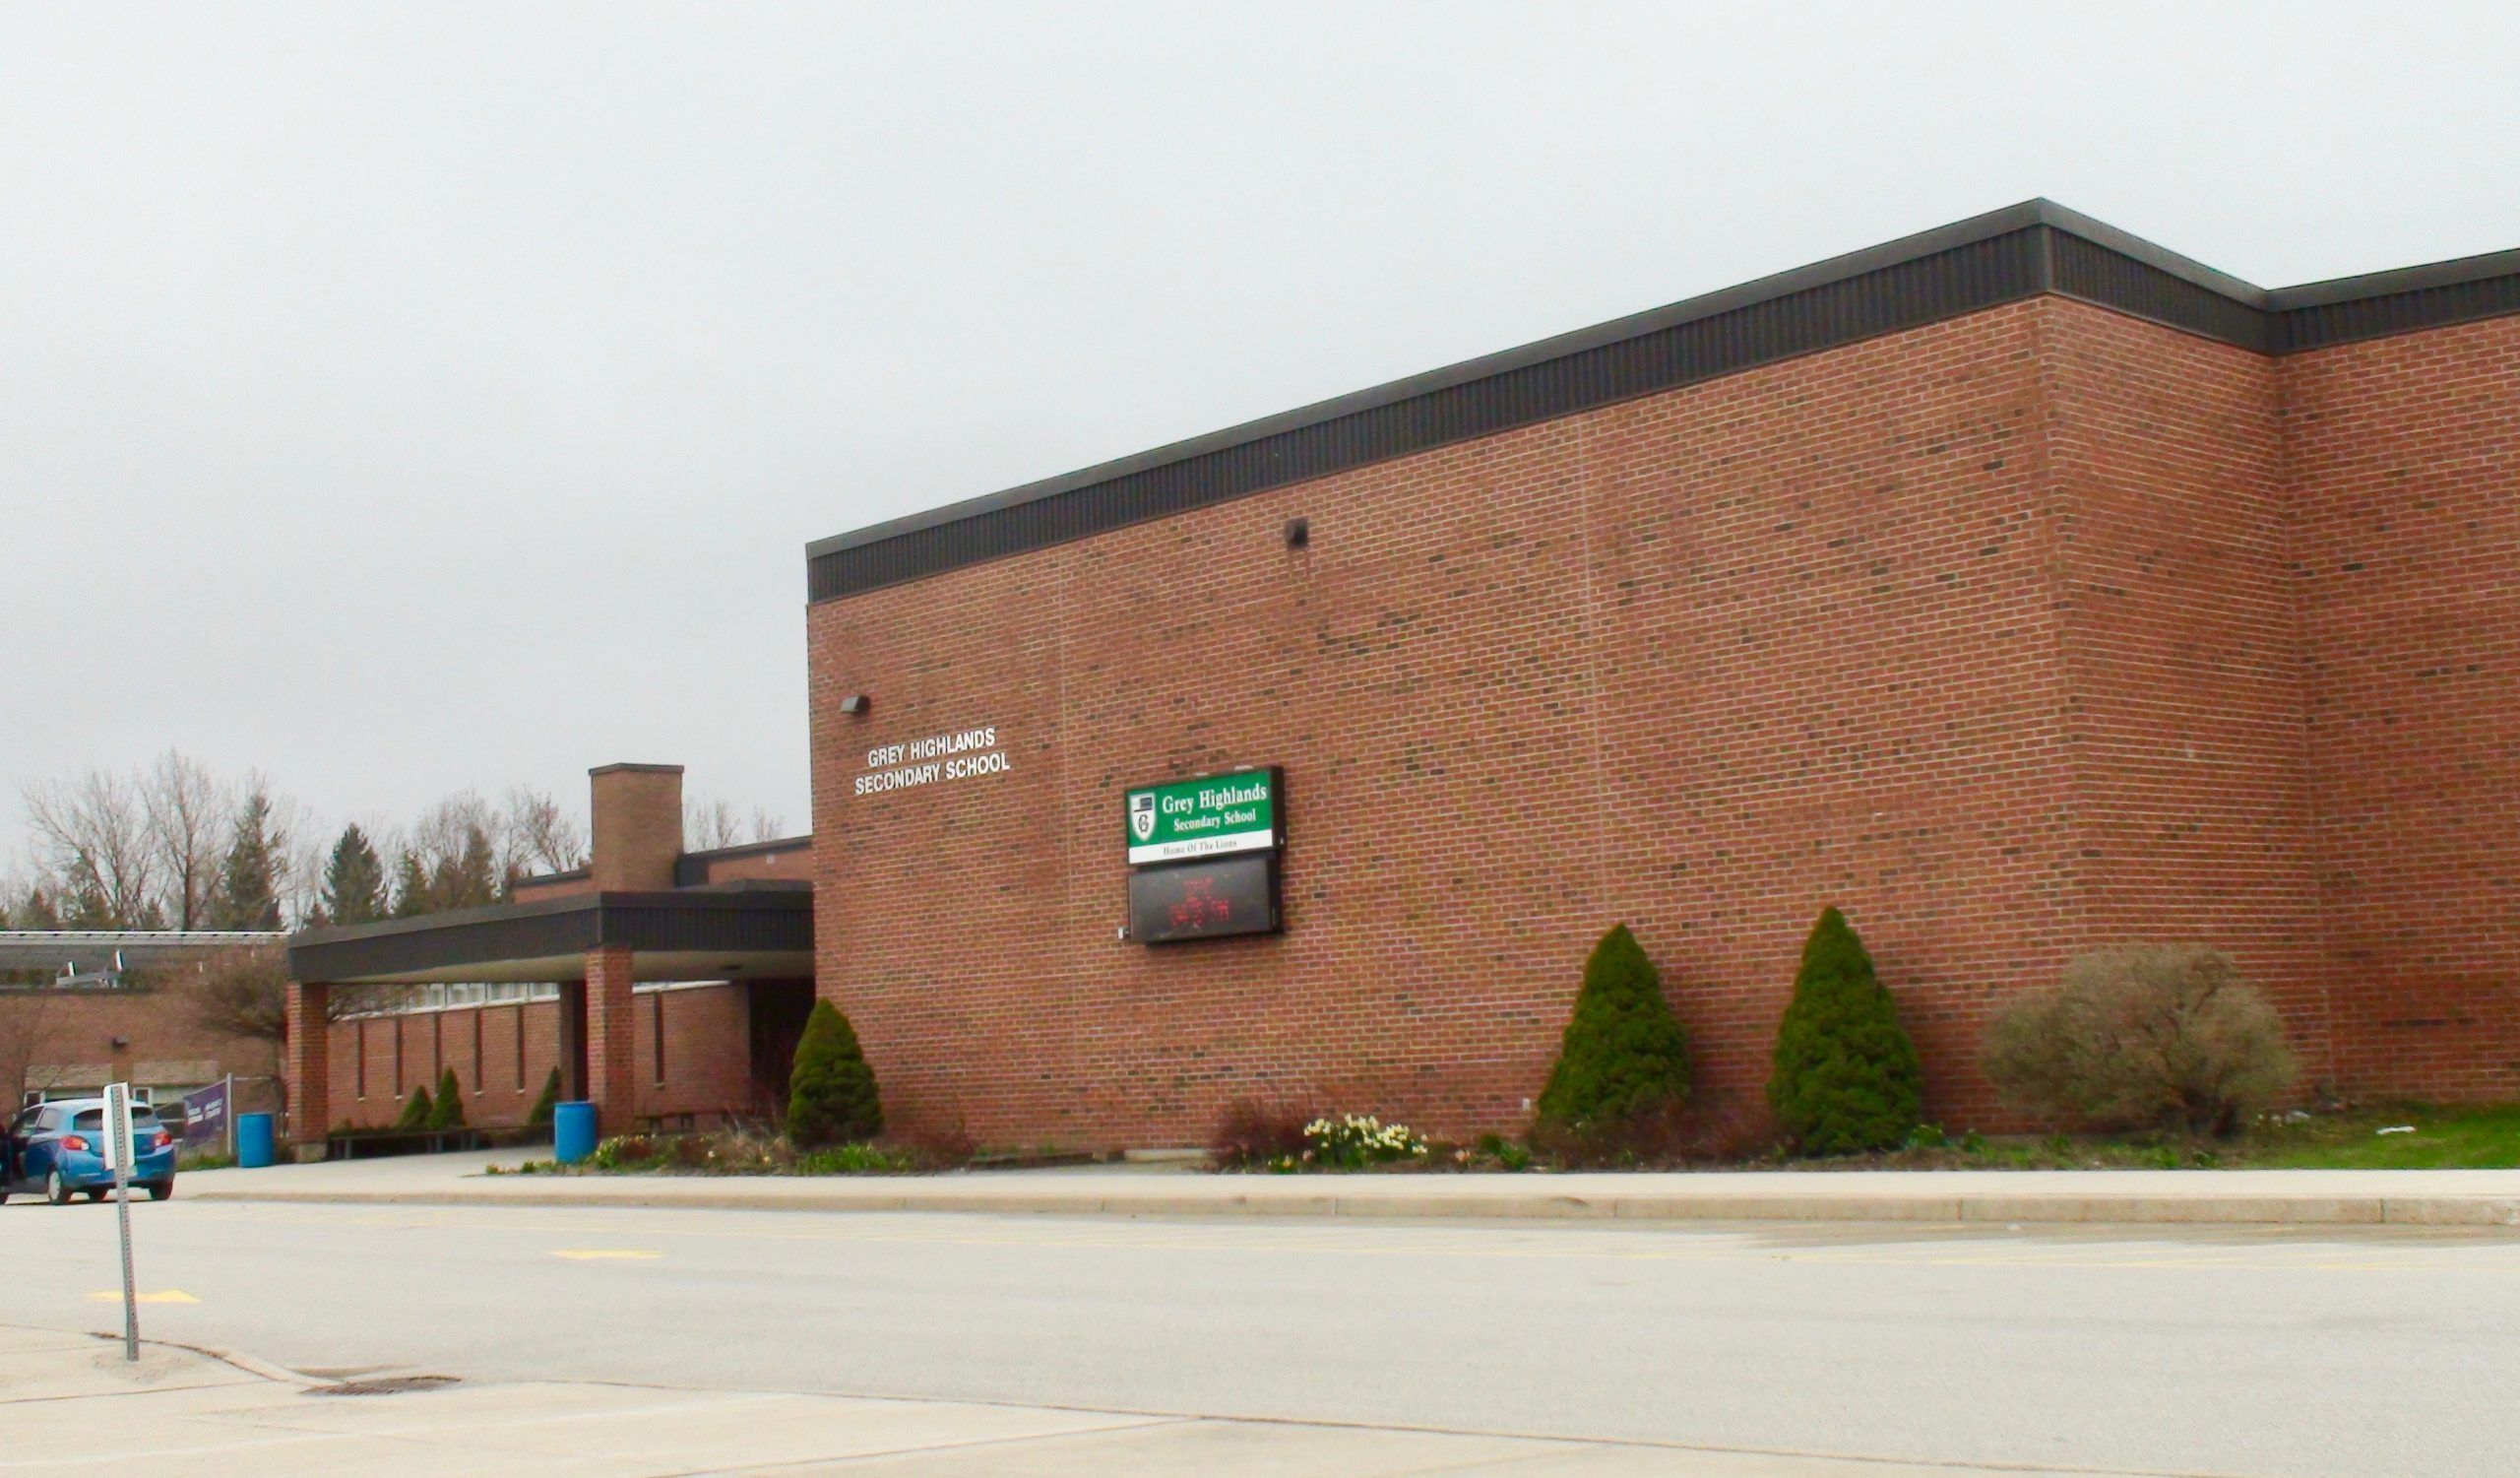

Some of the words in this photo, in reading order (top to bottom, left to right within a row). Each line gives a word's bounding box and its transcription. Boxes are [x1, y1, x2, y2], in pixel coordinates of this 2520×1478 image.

[868, 743, 905, 768] GREY
[911, 727, 995, 760] HIGHLANDS
[854, 763, 940, 796] SECONDARY
[946, 752, 1011, 779] SCHOOL
[1163, 796, 1194, 814] Grey
[1199, 783, 1267, 810] Highlands
[1173, 813, 1221, 831] Secondary
[1225, 808, 1256, 824] School
[1164, 846, 1185, 856] Home
[1187, 843, 1196, 853] Of
[1199, 841, 1214, 851] The
[1216, 840, 1237, 850] Lions
